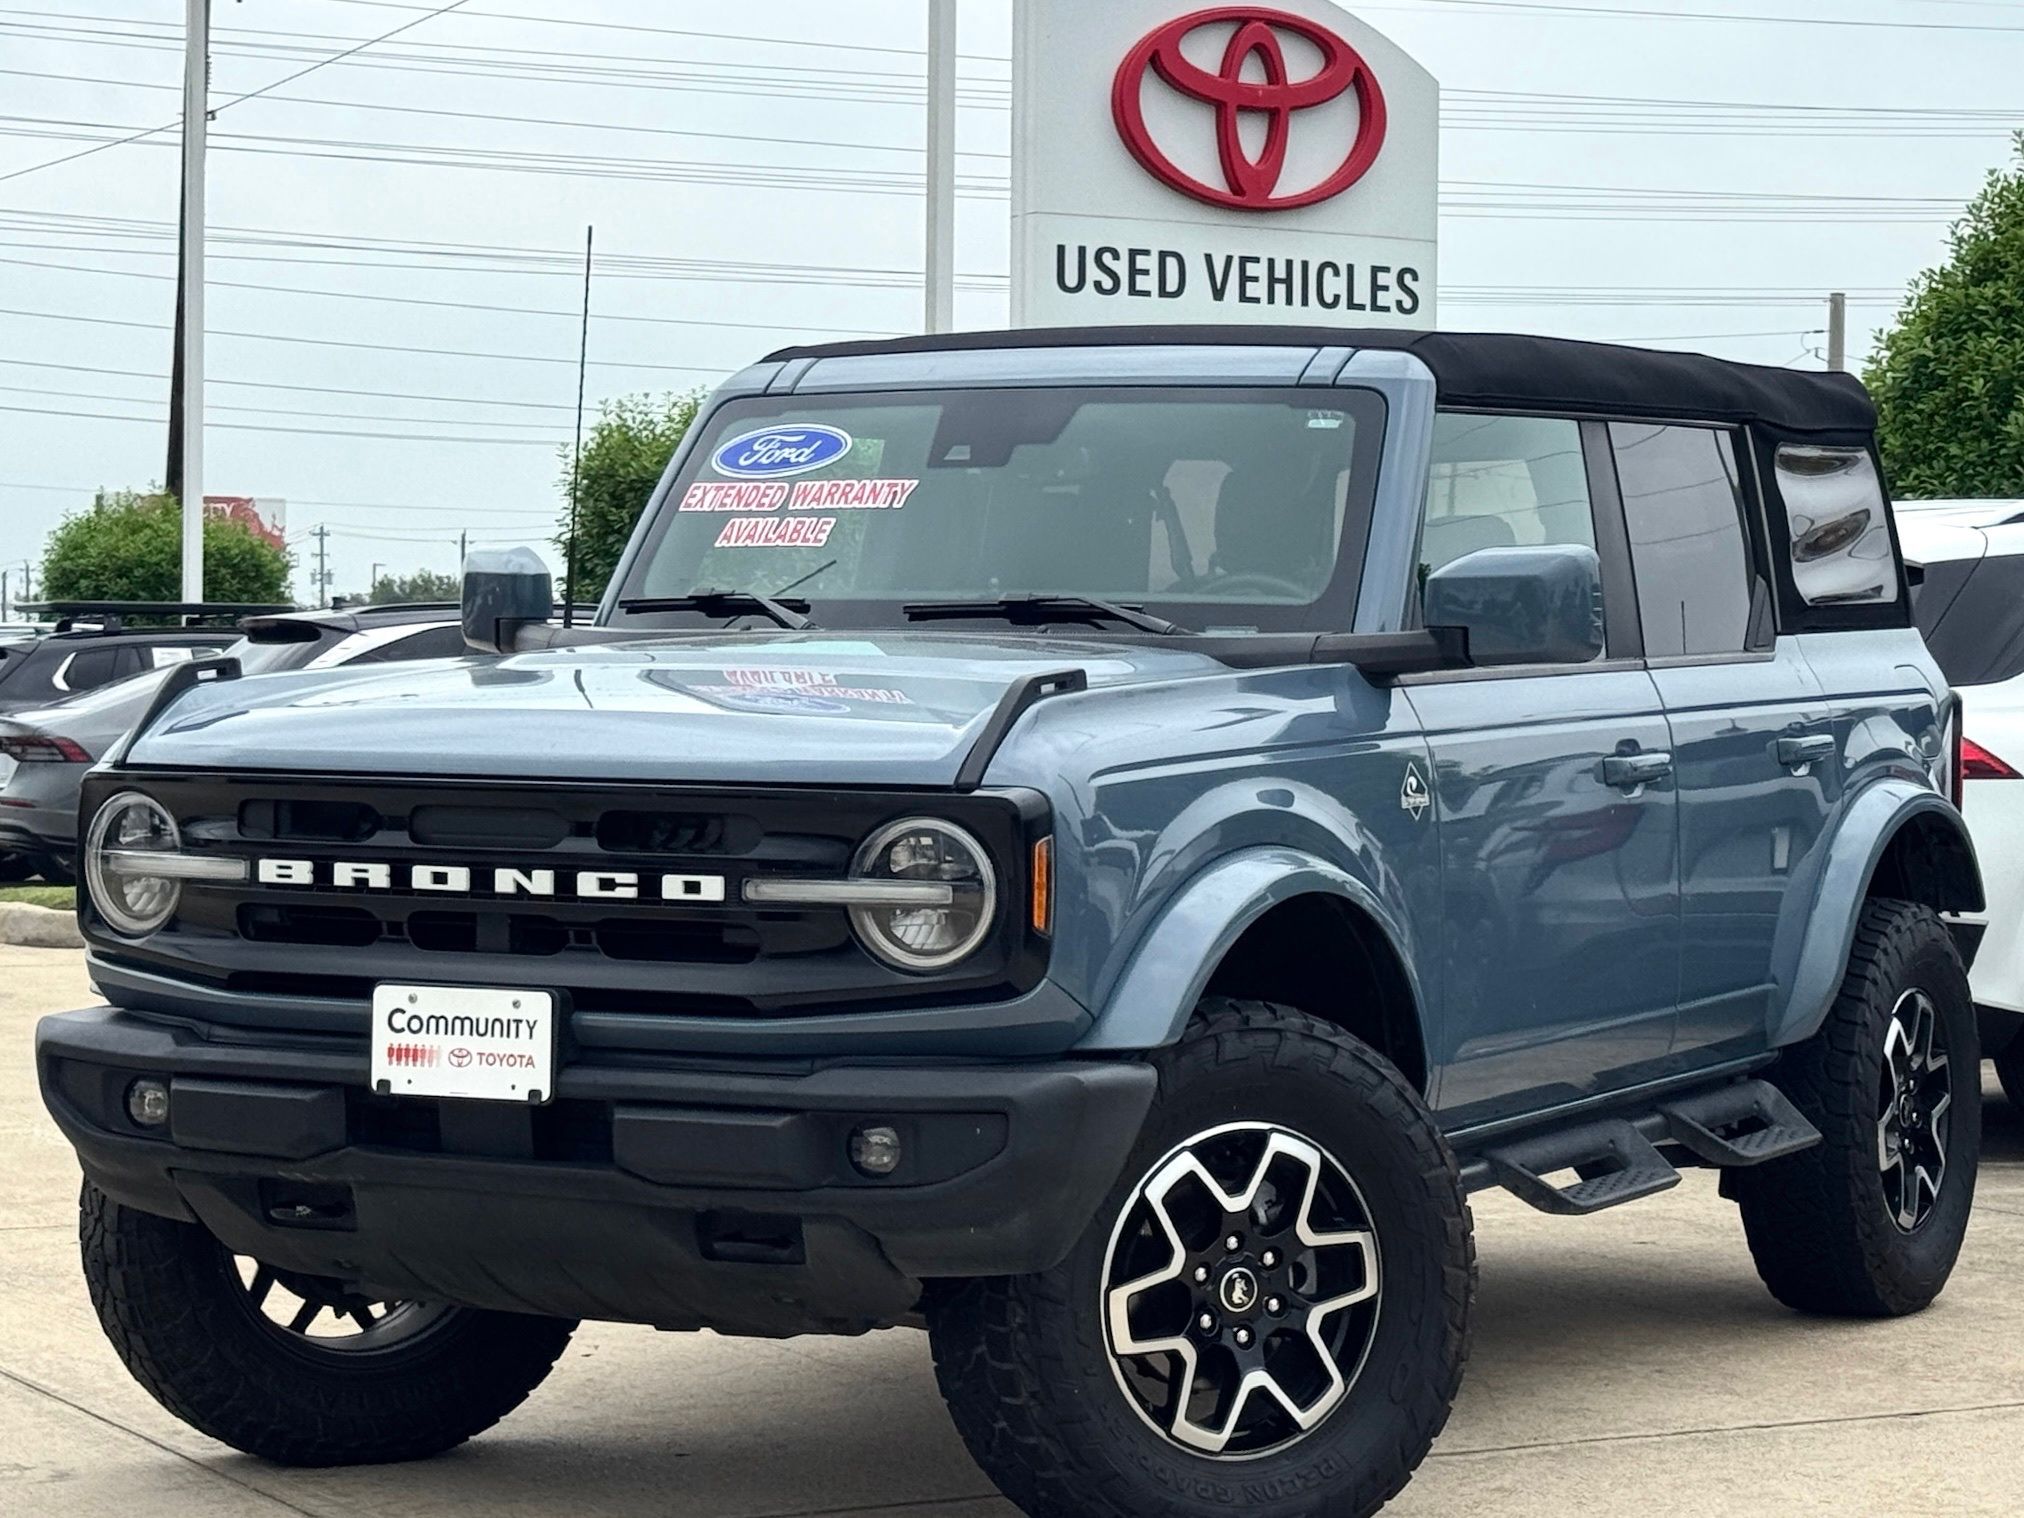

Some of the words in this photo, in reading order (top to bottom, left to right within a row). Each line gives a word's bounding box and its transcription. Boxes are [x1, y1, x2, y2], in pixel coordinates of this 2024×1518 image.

[1056, 243, 1187, 299] USED
[1203, 252, 1420, 315] VEHICLES
[737, 433, 823, 467] Ford
[681, 483, 788, 510] EXTENDED
[789, 481, 917, 509] WARRANTY
[716, 519, 835, 546] AVAILABLE
[257, 857, 727, 902] BRONCO
[476, 1051, 536, 1069] TOYOTA
